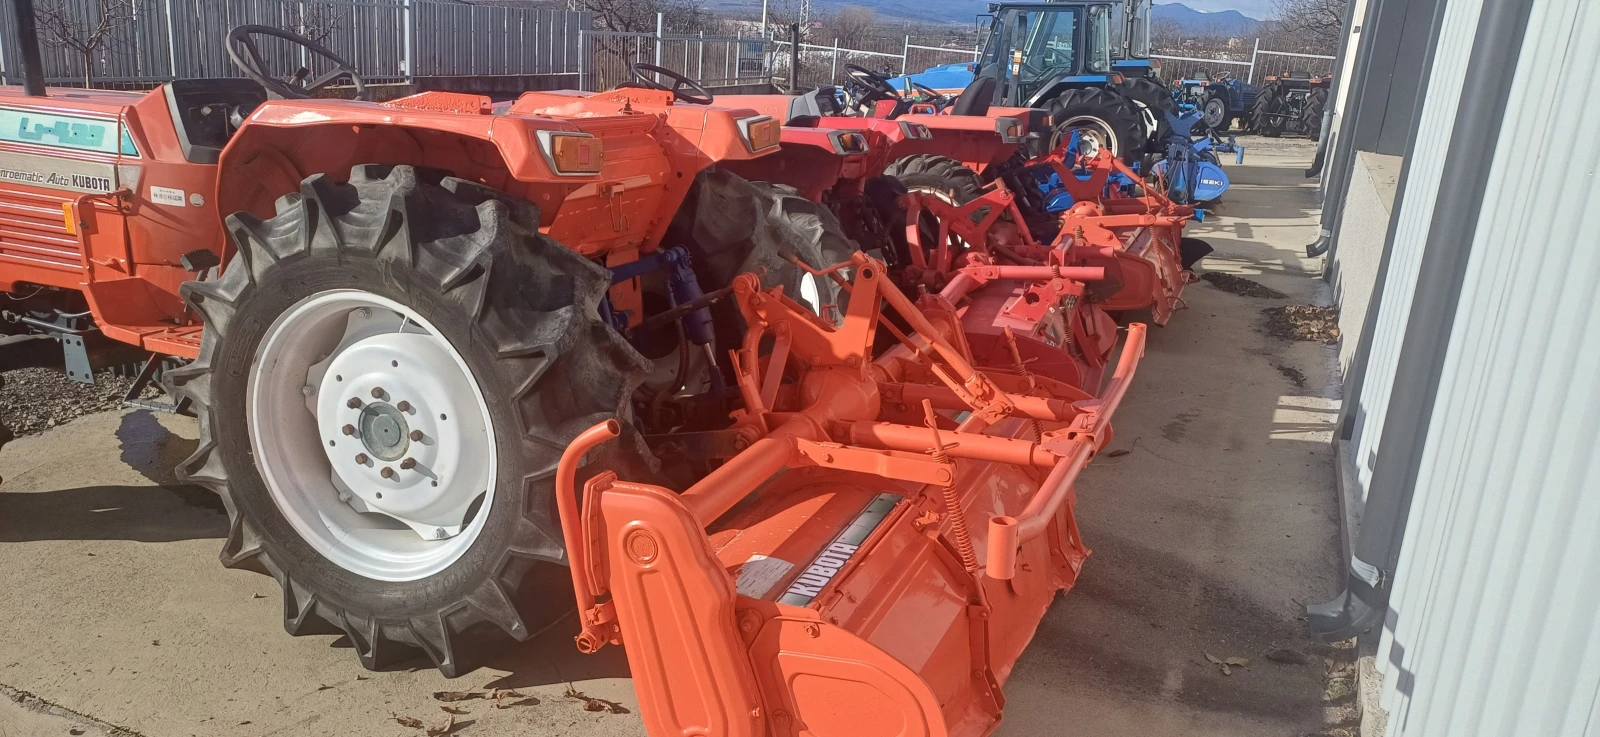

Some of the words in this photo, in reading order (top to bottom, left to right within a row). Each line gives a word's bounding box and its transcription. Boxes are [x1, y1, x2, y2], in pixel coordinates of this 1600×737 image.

[46, 172, 69, 187] Auto
[72, 174, 110, 192] KUBOTA
[1200, 178, 1223, 186] ISEKI
[786, 542, 859, 597] KUBOTA
